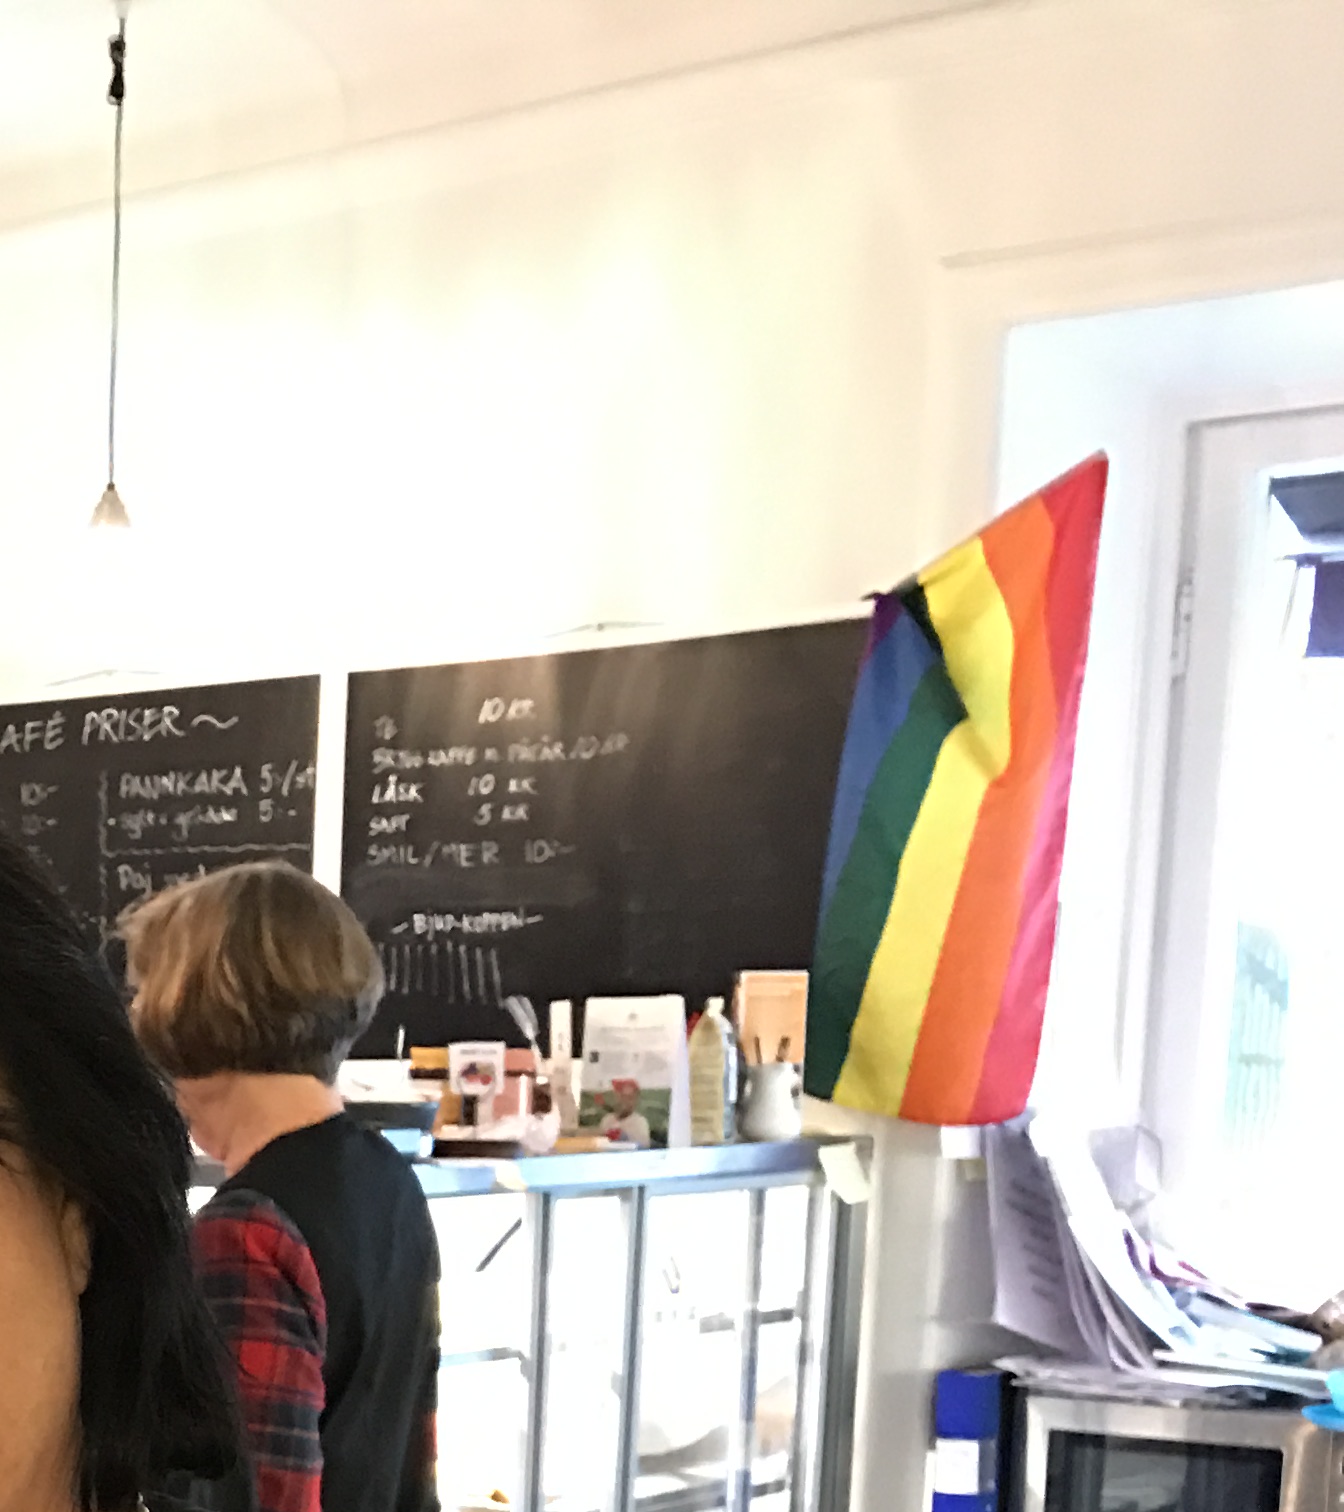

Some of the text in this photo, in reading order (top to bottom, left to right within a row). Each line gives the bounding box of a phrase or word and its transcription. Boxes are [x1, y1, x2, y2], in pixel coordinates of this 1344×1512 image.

[478, 696, 505, 724] 10
[81, 705, 186, 745] PRISER
[467, 774, 496, 797] 10
[473, 802, 493, 826] 5
